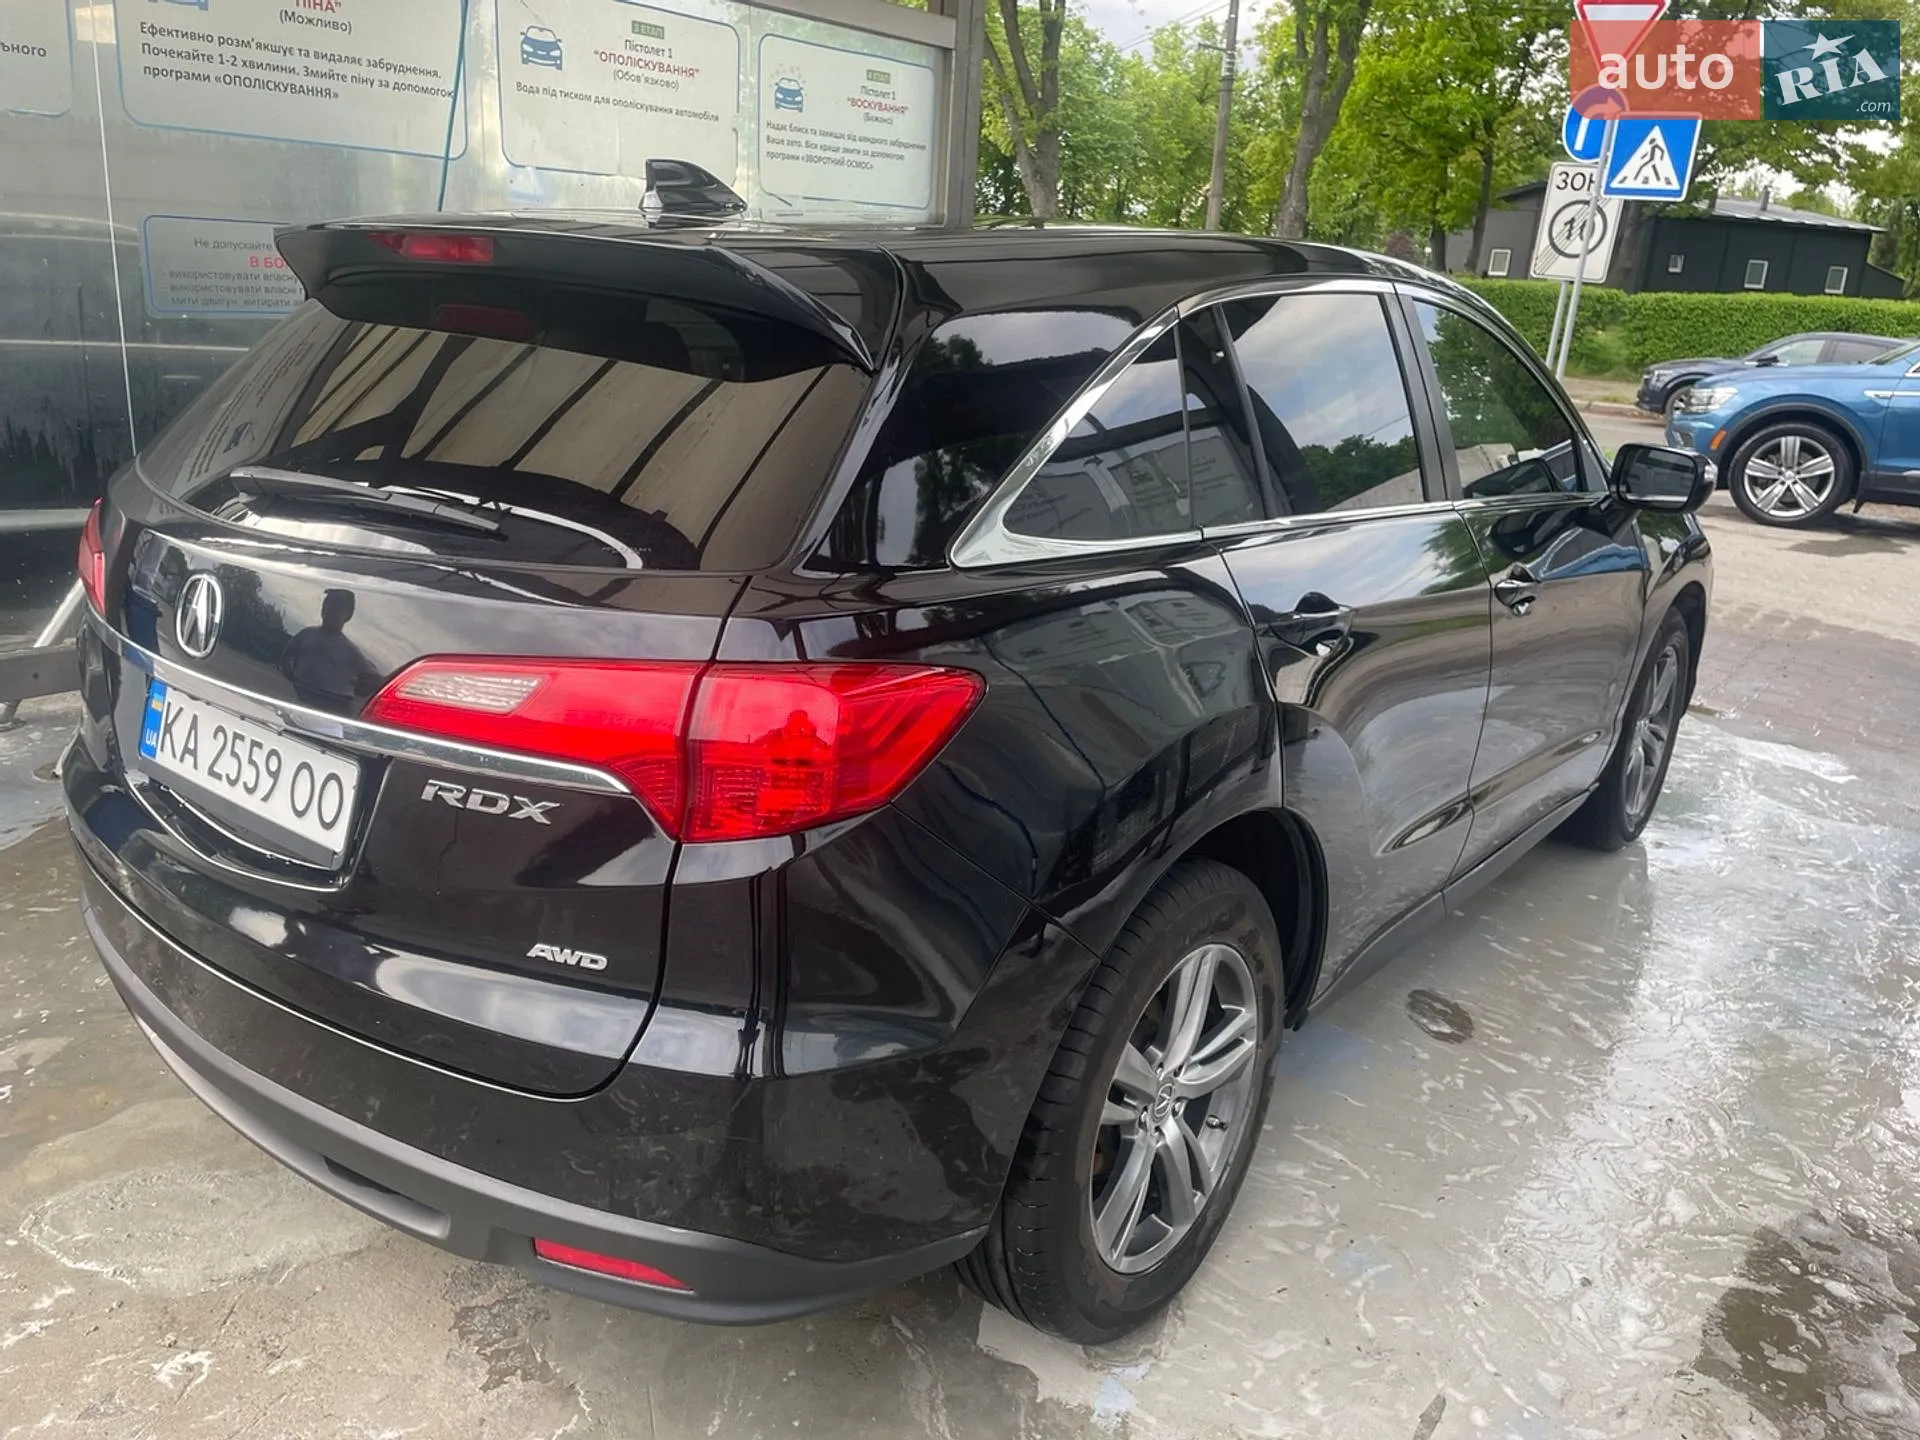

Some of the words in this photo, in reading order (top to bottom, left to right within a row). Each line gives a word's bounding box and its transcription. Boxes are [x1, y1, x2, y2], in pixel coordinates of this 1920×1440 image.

[280, 9, 352, 35] (Можливо)
[140, 21, 214, 44] Ефективно
[218, 36, 295, 57] розм'якшує
[297, 48, 310, 58] та
[313, 50, 362, 67] видаляє
[366, 58, 442, 79] забруднення.
[624, 39, 665, 57] Пістолет
[668, 48, 672, 59] 1
[141, 42, 214, 64] Почекайте
[218, 53, 238, 67] 1-2
[241, 58, 300, 76] хвилини.
[303, 65, 347, 83] Змийте
[350, 74, 375, 89] піну
[378, 79, 390, 89] за
[594, 50, 700, 78] "ОПОЛІСКУВАННЯ"
[143, 66, 211, 83] програми
[215, 74, 339, 100] «ОПОЛІСКУВАННЯ»
[613, 70, 680, 92] (Обов'язково)
[516, 81, 540, 95] Вода
[542, 86, 557, 98] під
[559, 90, 592, 102] тиском
[593, 95, 610, 106] для
[612, 98, 673, 116] ополіскування
[675, 107, 719, 122] автомобіля
[194, 238, 208, 249] Не
[249, 256, 259, 268] В
[264, 257, 287, 269] БО
[145, 728, 157, 747] UA
[206, 724, 283, 804] 2559
[421, 779, 561, 825] RDX
[526, 943, 608, 971] AWD
